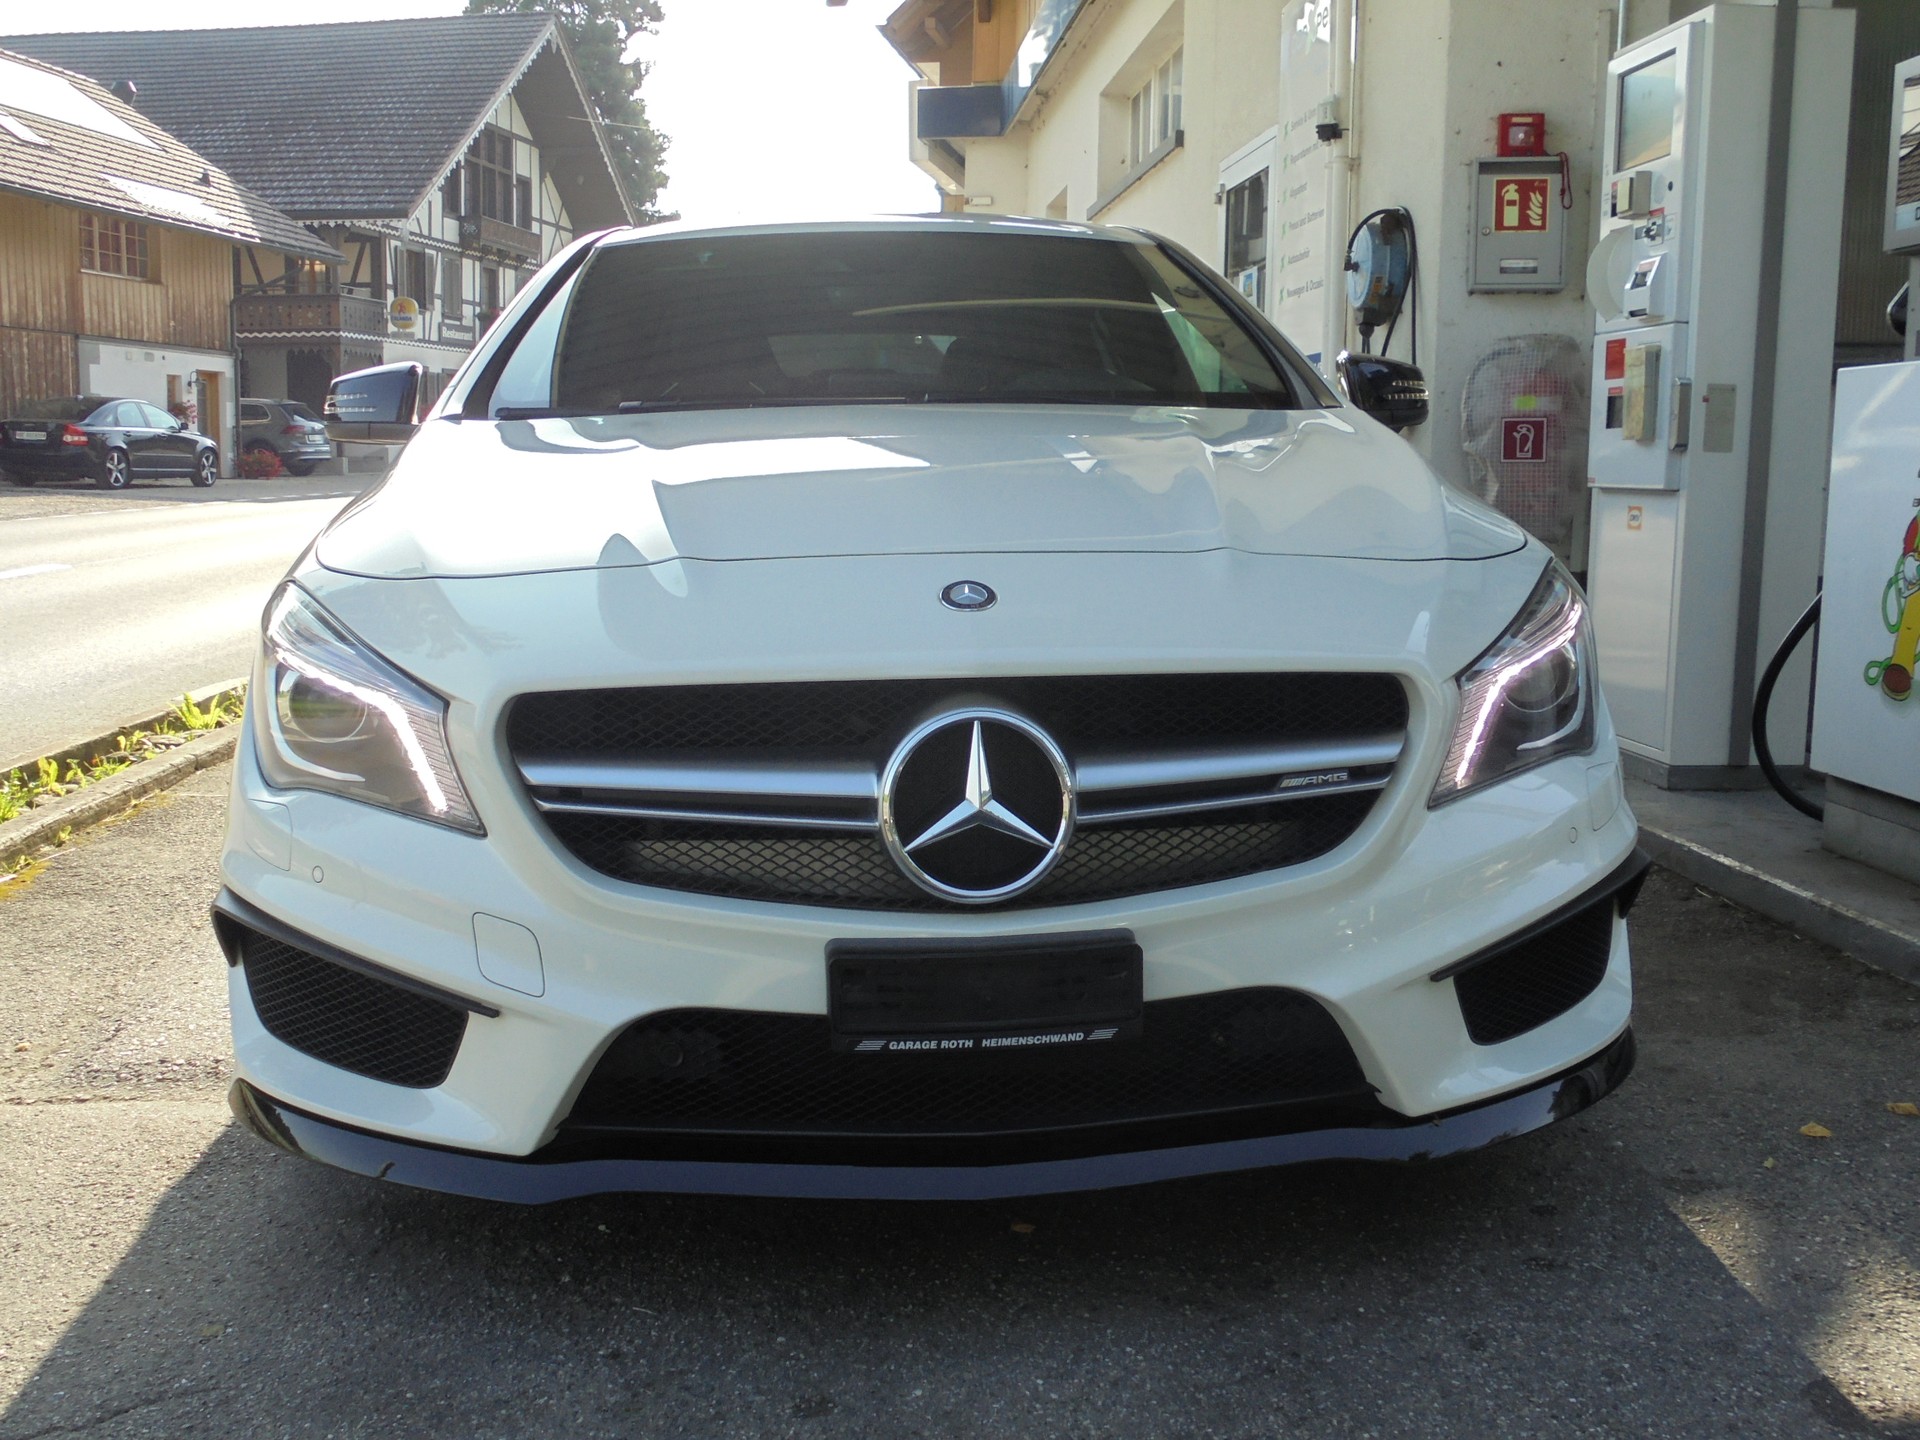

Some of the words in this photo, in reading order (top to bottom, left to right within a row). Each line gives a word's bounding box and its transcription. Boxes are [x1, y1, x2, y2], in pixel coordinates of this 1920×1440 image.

[442, 326, 473, 341] Restaurant
[1302, 772, 1348, 786] AMG
[889, 1040, 939, 1050] GARAGE
[940, 1039, 974, 1050] ROTH
[981, 1032, 1085, 1048] HEIMENSCHWAND
